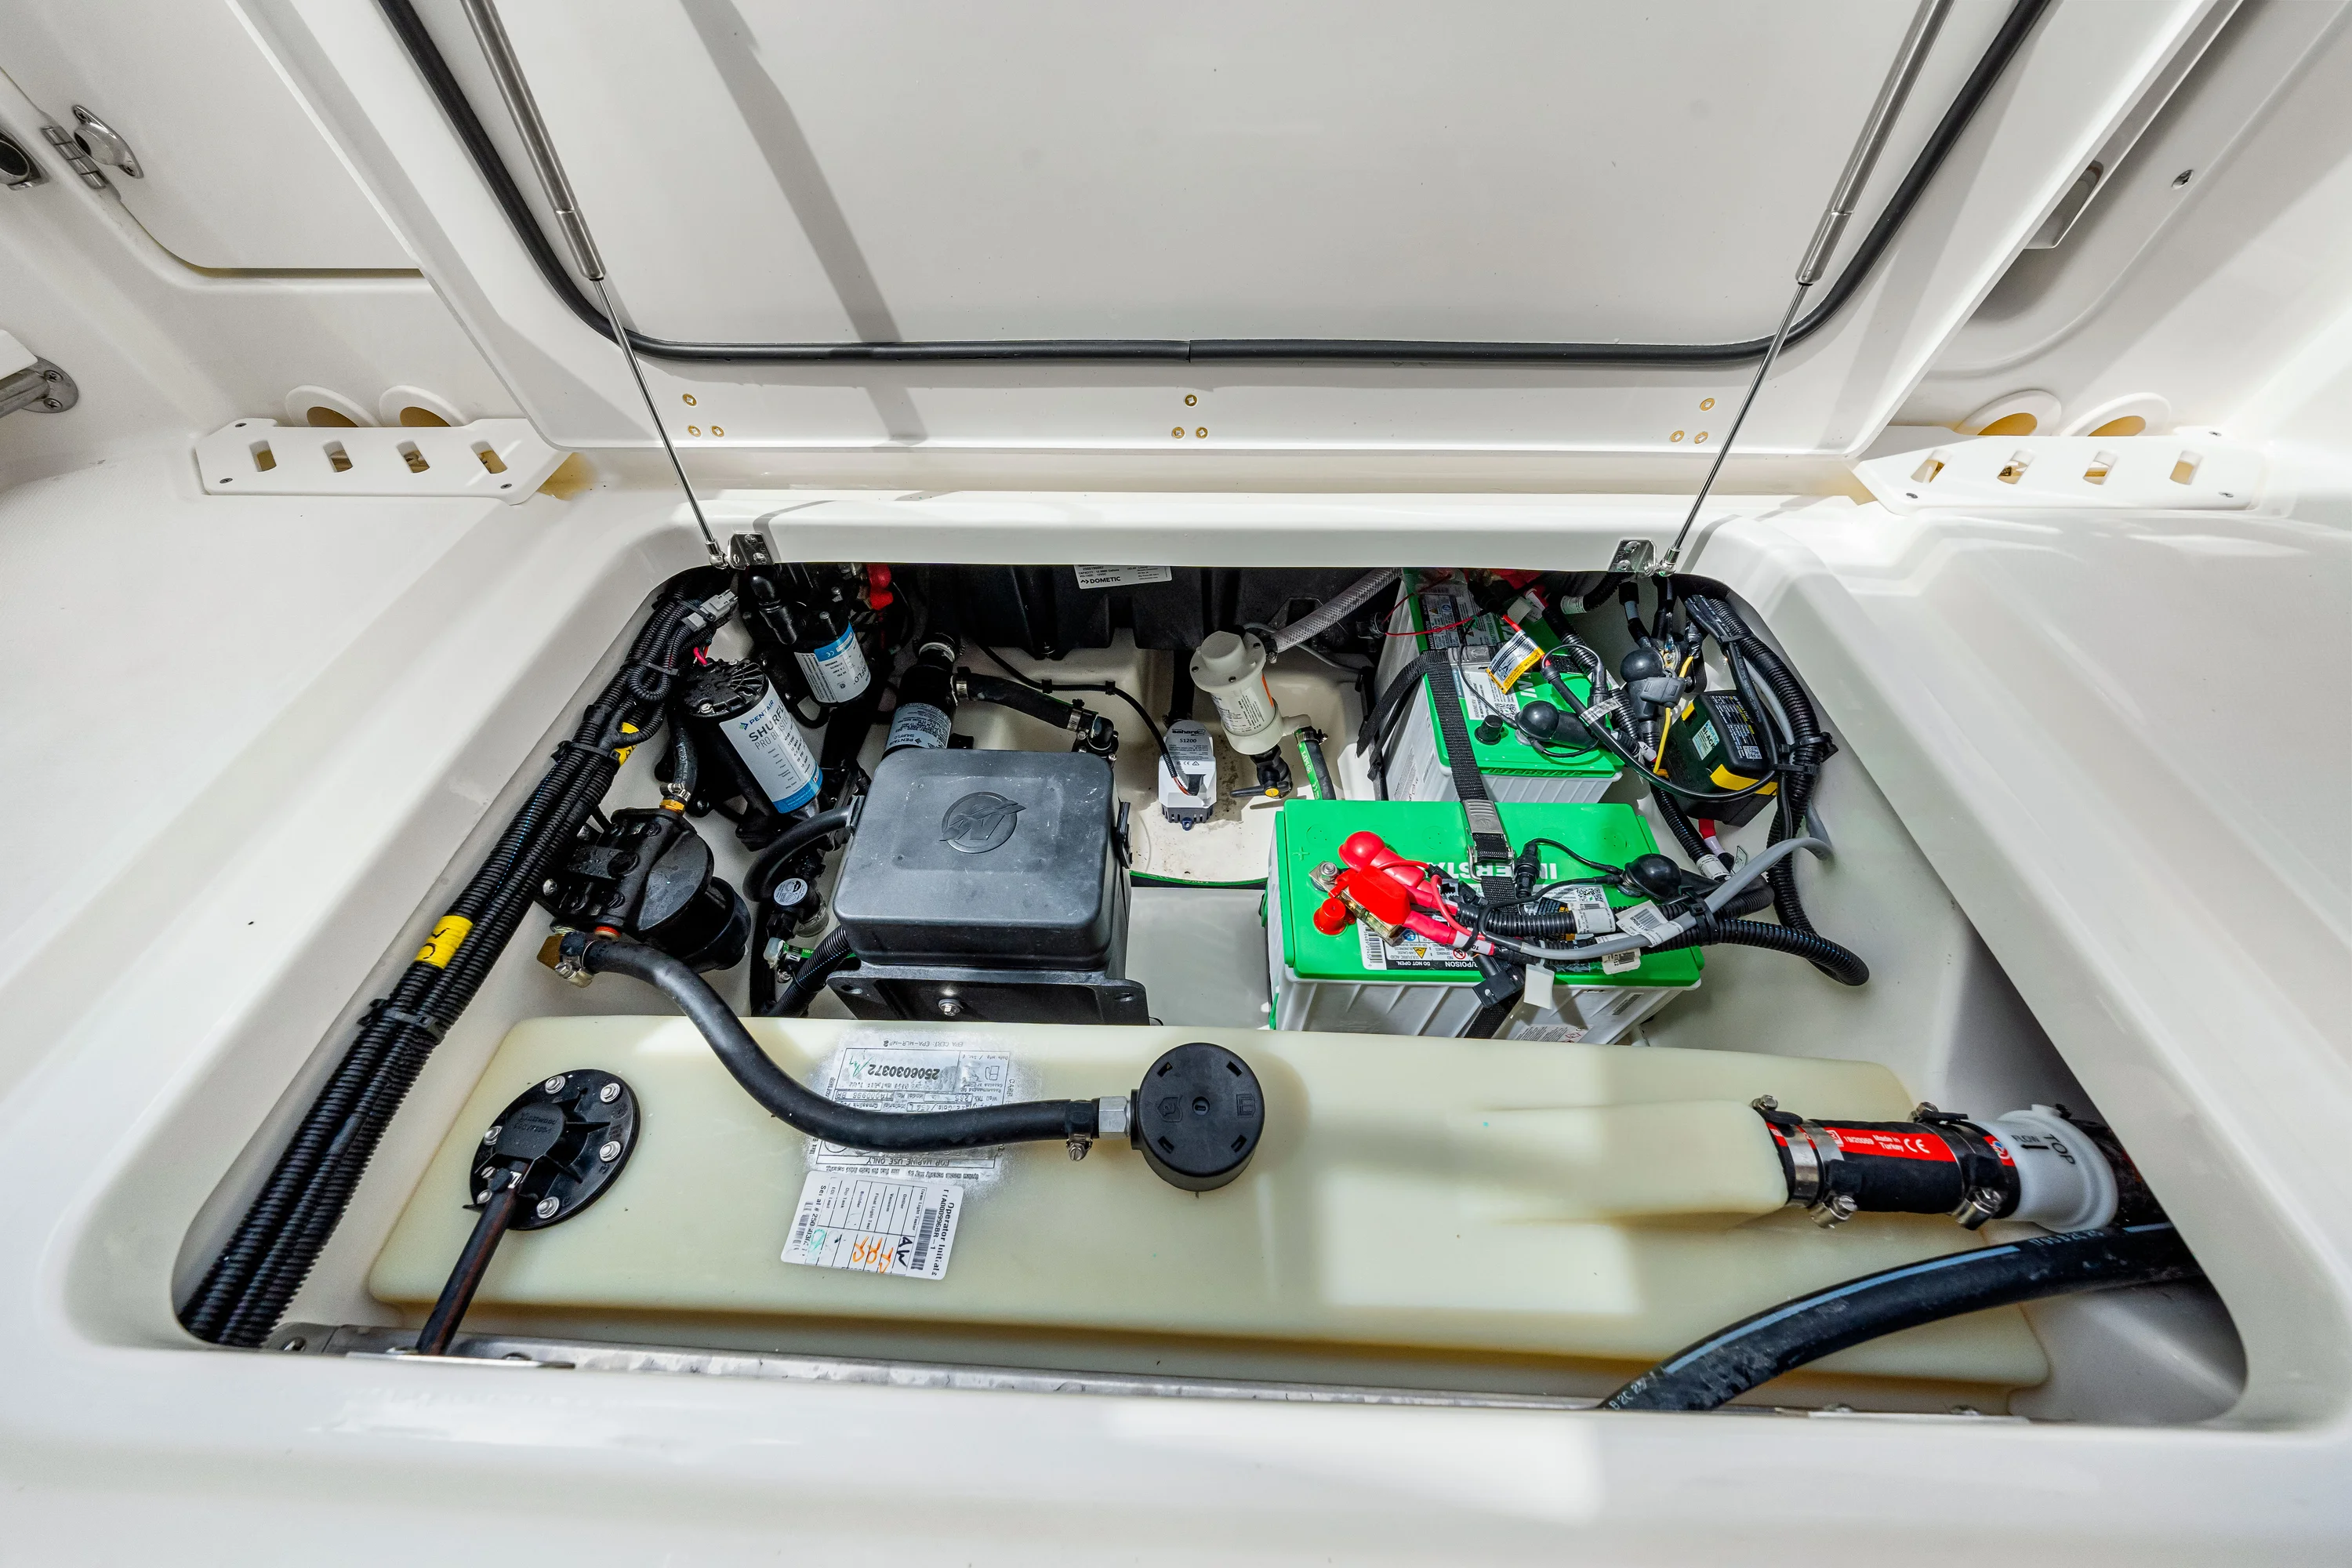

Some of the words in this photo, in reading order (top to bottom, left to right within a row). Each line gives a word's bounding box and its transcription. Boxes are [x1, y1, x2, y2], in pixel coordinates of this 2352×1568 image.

[1523, 654, 1537, 667] ATTENTION
[748, 699, 775, 725] PENTAIR
[753, 734, 772, 752] PRO
[1300, 750, 1310, 765] MPI
[1488, 768, 1582, 776] INTERSTATE
[868, 1064, 940, 1080] 2506030372
[1878, 1142, 1904, 1152] Turkey
[2042, 1133, 2075, 1164] TOP
[866, 1155, 886, 1166] ONLY
[888, 1156, 903, 1166] USE
[934, 1158, 949, 1167] FOR
[855, 1190, 864, 1208] Builder
[884, 1192, 894, 1212] Vacuum
[939, 1201, 955, 1241] Operator
[931, 1243, 945, 1276] Initials
